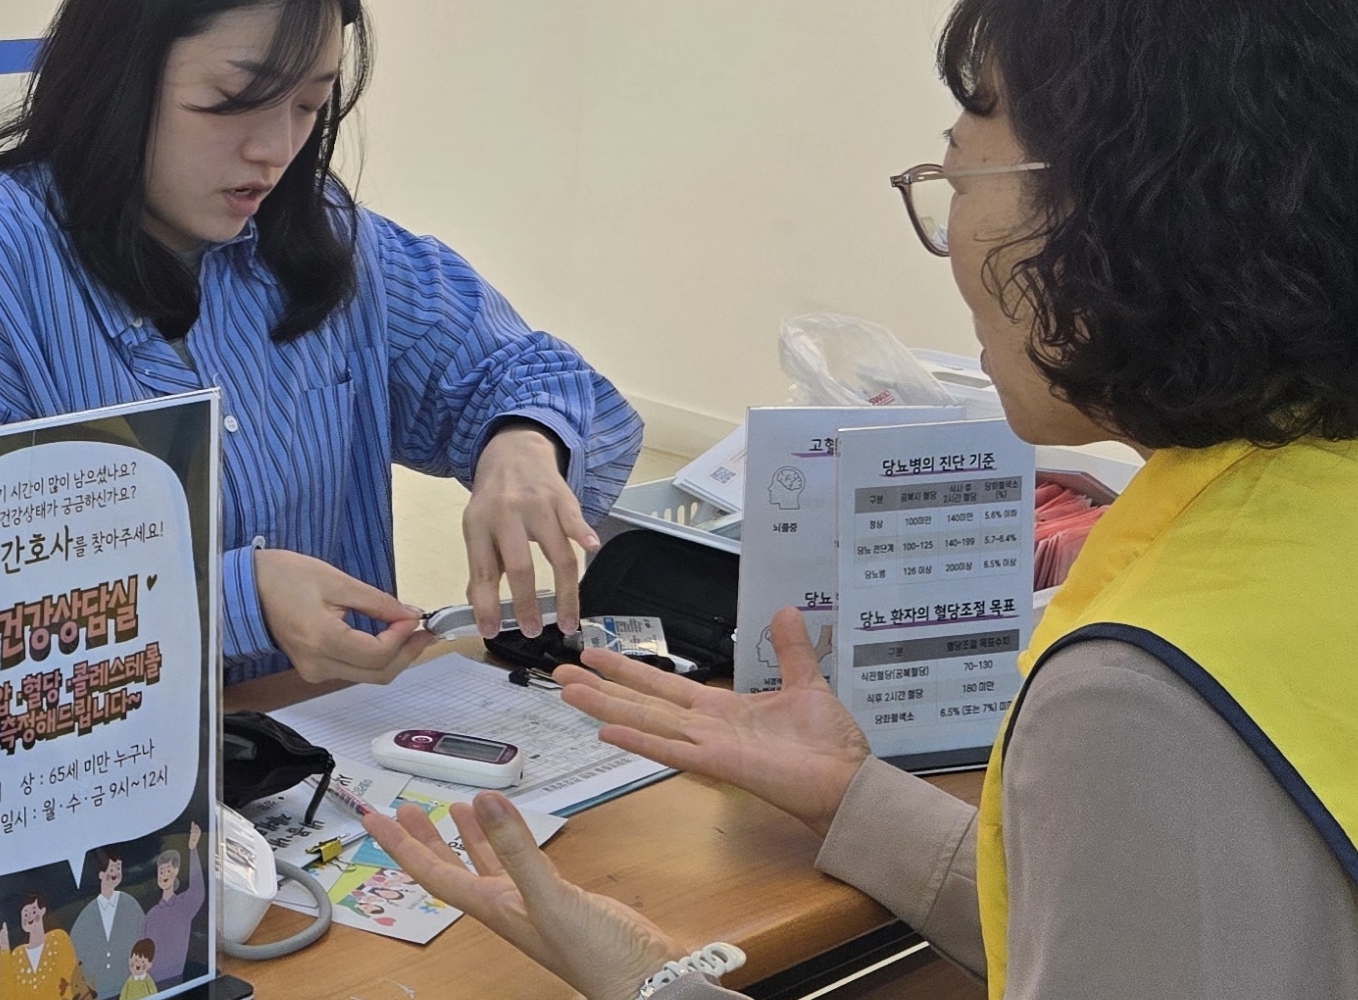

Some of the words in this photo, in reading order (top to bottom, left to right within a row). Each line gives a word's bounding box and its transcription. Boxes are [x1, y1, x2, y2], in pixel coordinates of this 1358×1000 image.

[882, 456, 935, 476] 당뇨병의
[940, 454, 965, 472] 진단
[970, 452, 996, 470] 기준
[10, 477, 44, 501] 시간이
[48, 472, 70, 494] 많이
[74, 462, 137, 489] 남으셨나요?
[868, 495, 884, 504] 구분
[0, 500, 57, 528] 건강상태가
[61, 485, 137, 515] 궁금하신가요?
[905, 516, 932, 526] 100미만
[947, 512, 974, 523] 140미만
[1, 525, 87, 574] 간호사를
[92, 521, 164, 554] 찾아주세요!
[903, 541, 933, 551] 100-125
[945, 537, 975, 547] 140-199
[945, 562, 972, 572] 200이상
[1003, 558, 1017, 567] 이상
[864, 569, 886, 579] 당뇨병
[918, 566, 932, 575] 이상
[860, 611, 886, 629] 당뇨
[890, 605, 929, 625] 환자의
[934, 600, 986, 621] 혈당조절
[989, 598, 1016, 617] 목표
[964, 660, 993, 671] 70-130
[978, 681, 995, 691] 미만
[867, 693, 882, 704] 식후
[885, 690, 906, 702] 2시간
[908, 688, 924, 700] 혈당
[874, 712, 915, 725] 당화혈색소
[49, 759, 78, 785] 65세
[84, 751, 110, 775] 미만
[114, 738, 156, 767] 누구나
[109, 764, 169, 799] 9시~12시
